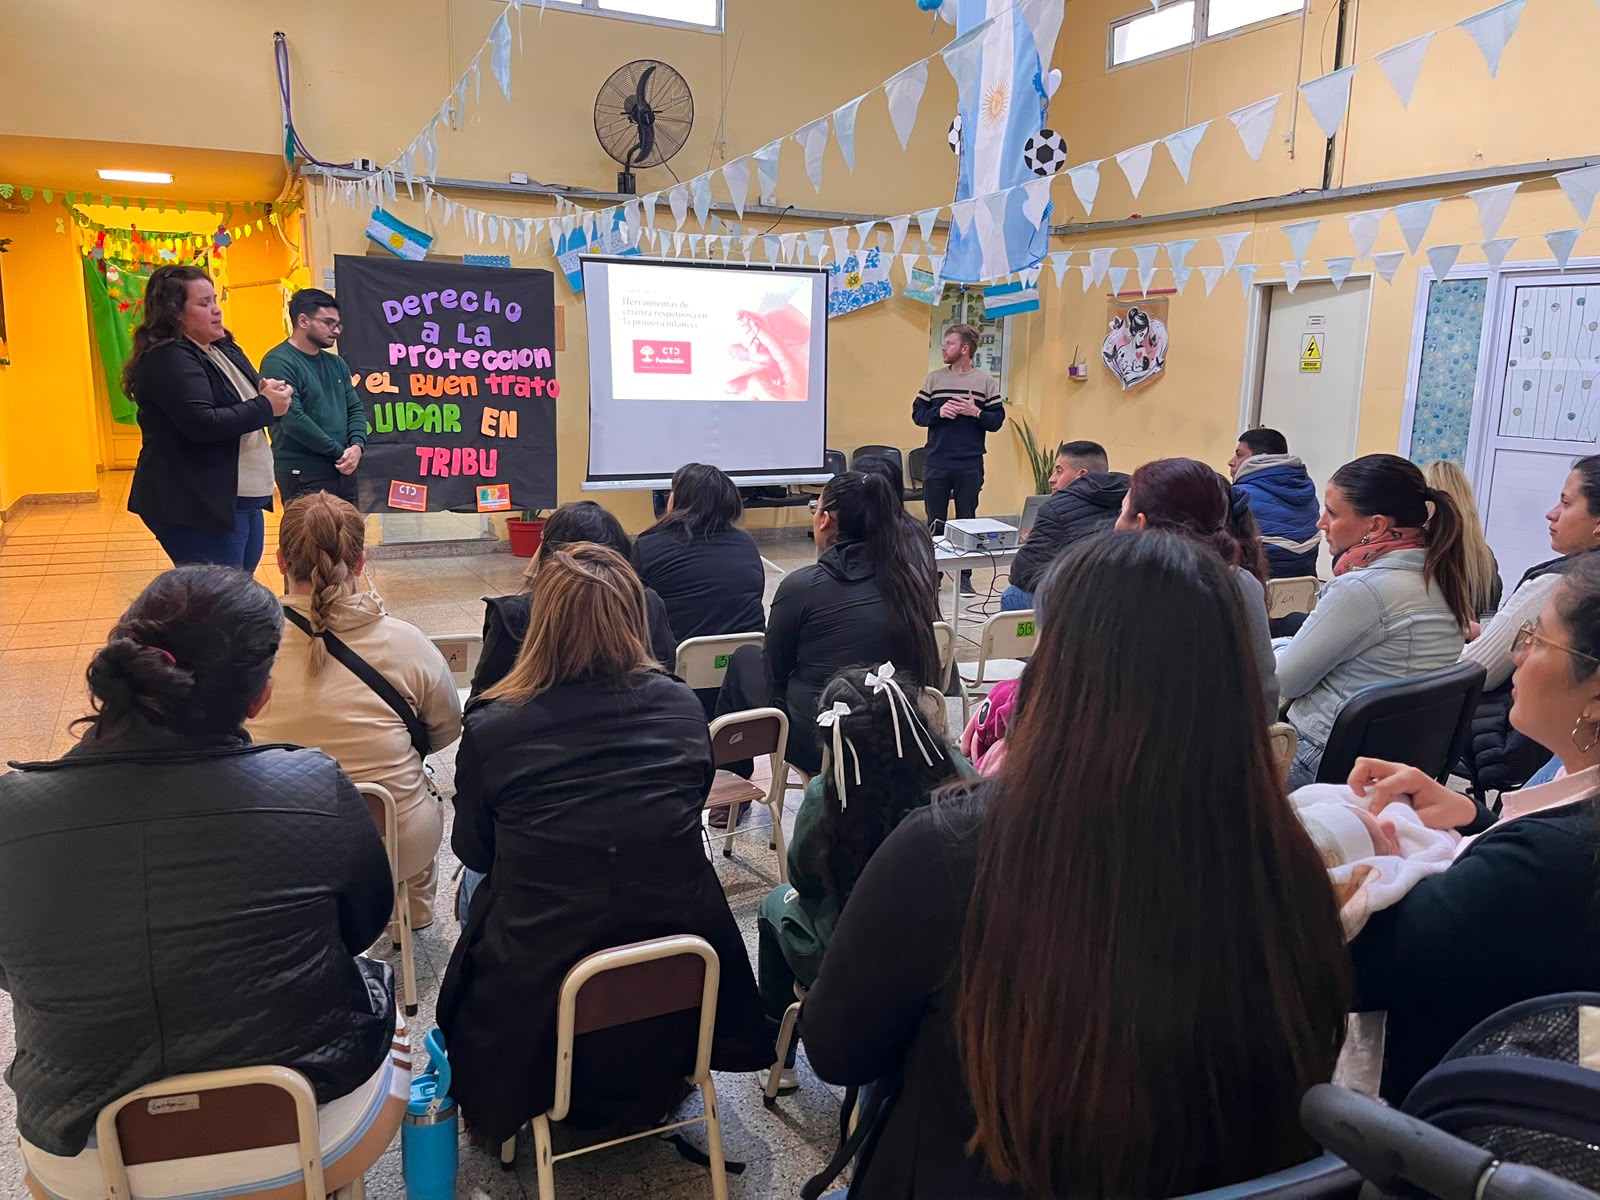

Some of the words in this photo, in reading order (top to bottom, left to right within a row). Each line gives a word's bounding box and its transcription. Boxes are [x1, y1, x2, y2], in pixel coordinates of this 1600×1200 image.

[382, 288, 523, 324] Derecho
[622, 297, 678, 308] Herramientas
[679, 299, 689, 308] de
[622, 309, 652, 317] crianza
[654, 311, 696, 320] respetuosa
[421, 322, 440, 344] a
[457, 323, 492, 347] La
[623, 317, 631, 326] la
[632, 319, 665, 328] primera
[666, 320, 698, 329] infancia
[485, 372, 561, 399] trato
[366, 402, 463, 435] UIDAR
[481, 406, 519, 439] EN
[416, 446, 498, 478] TRIBU
[1017, 622, 1032, 636] 3B
